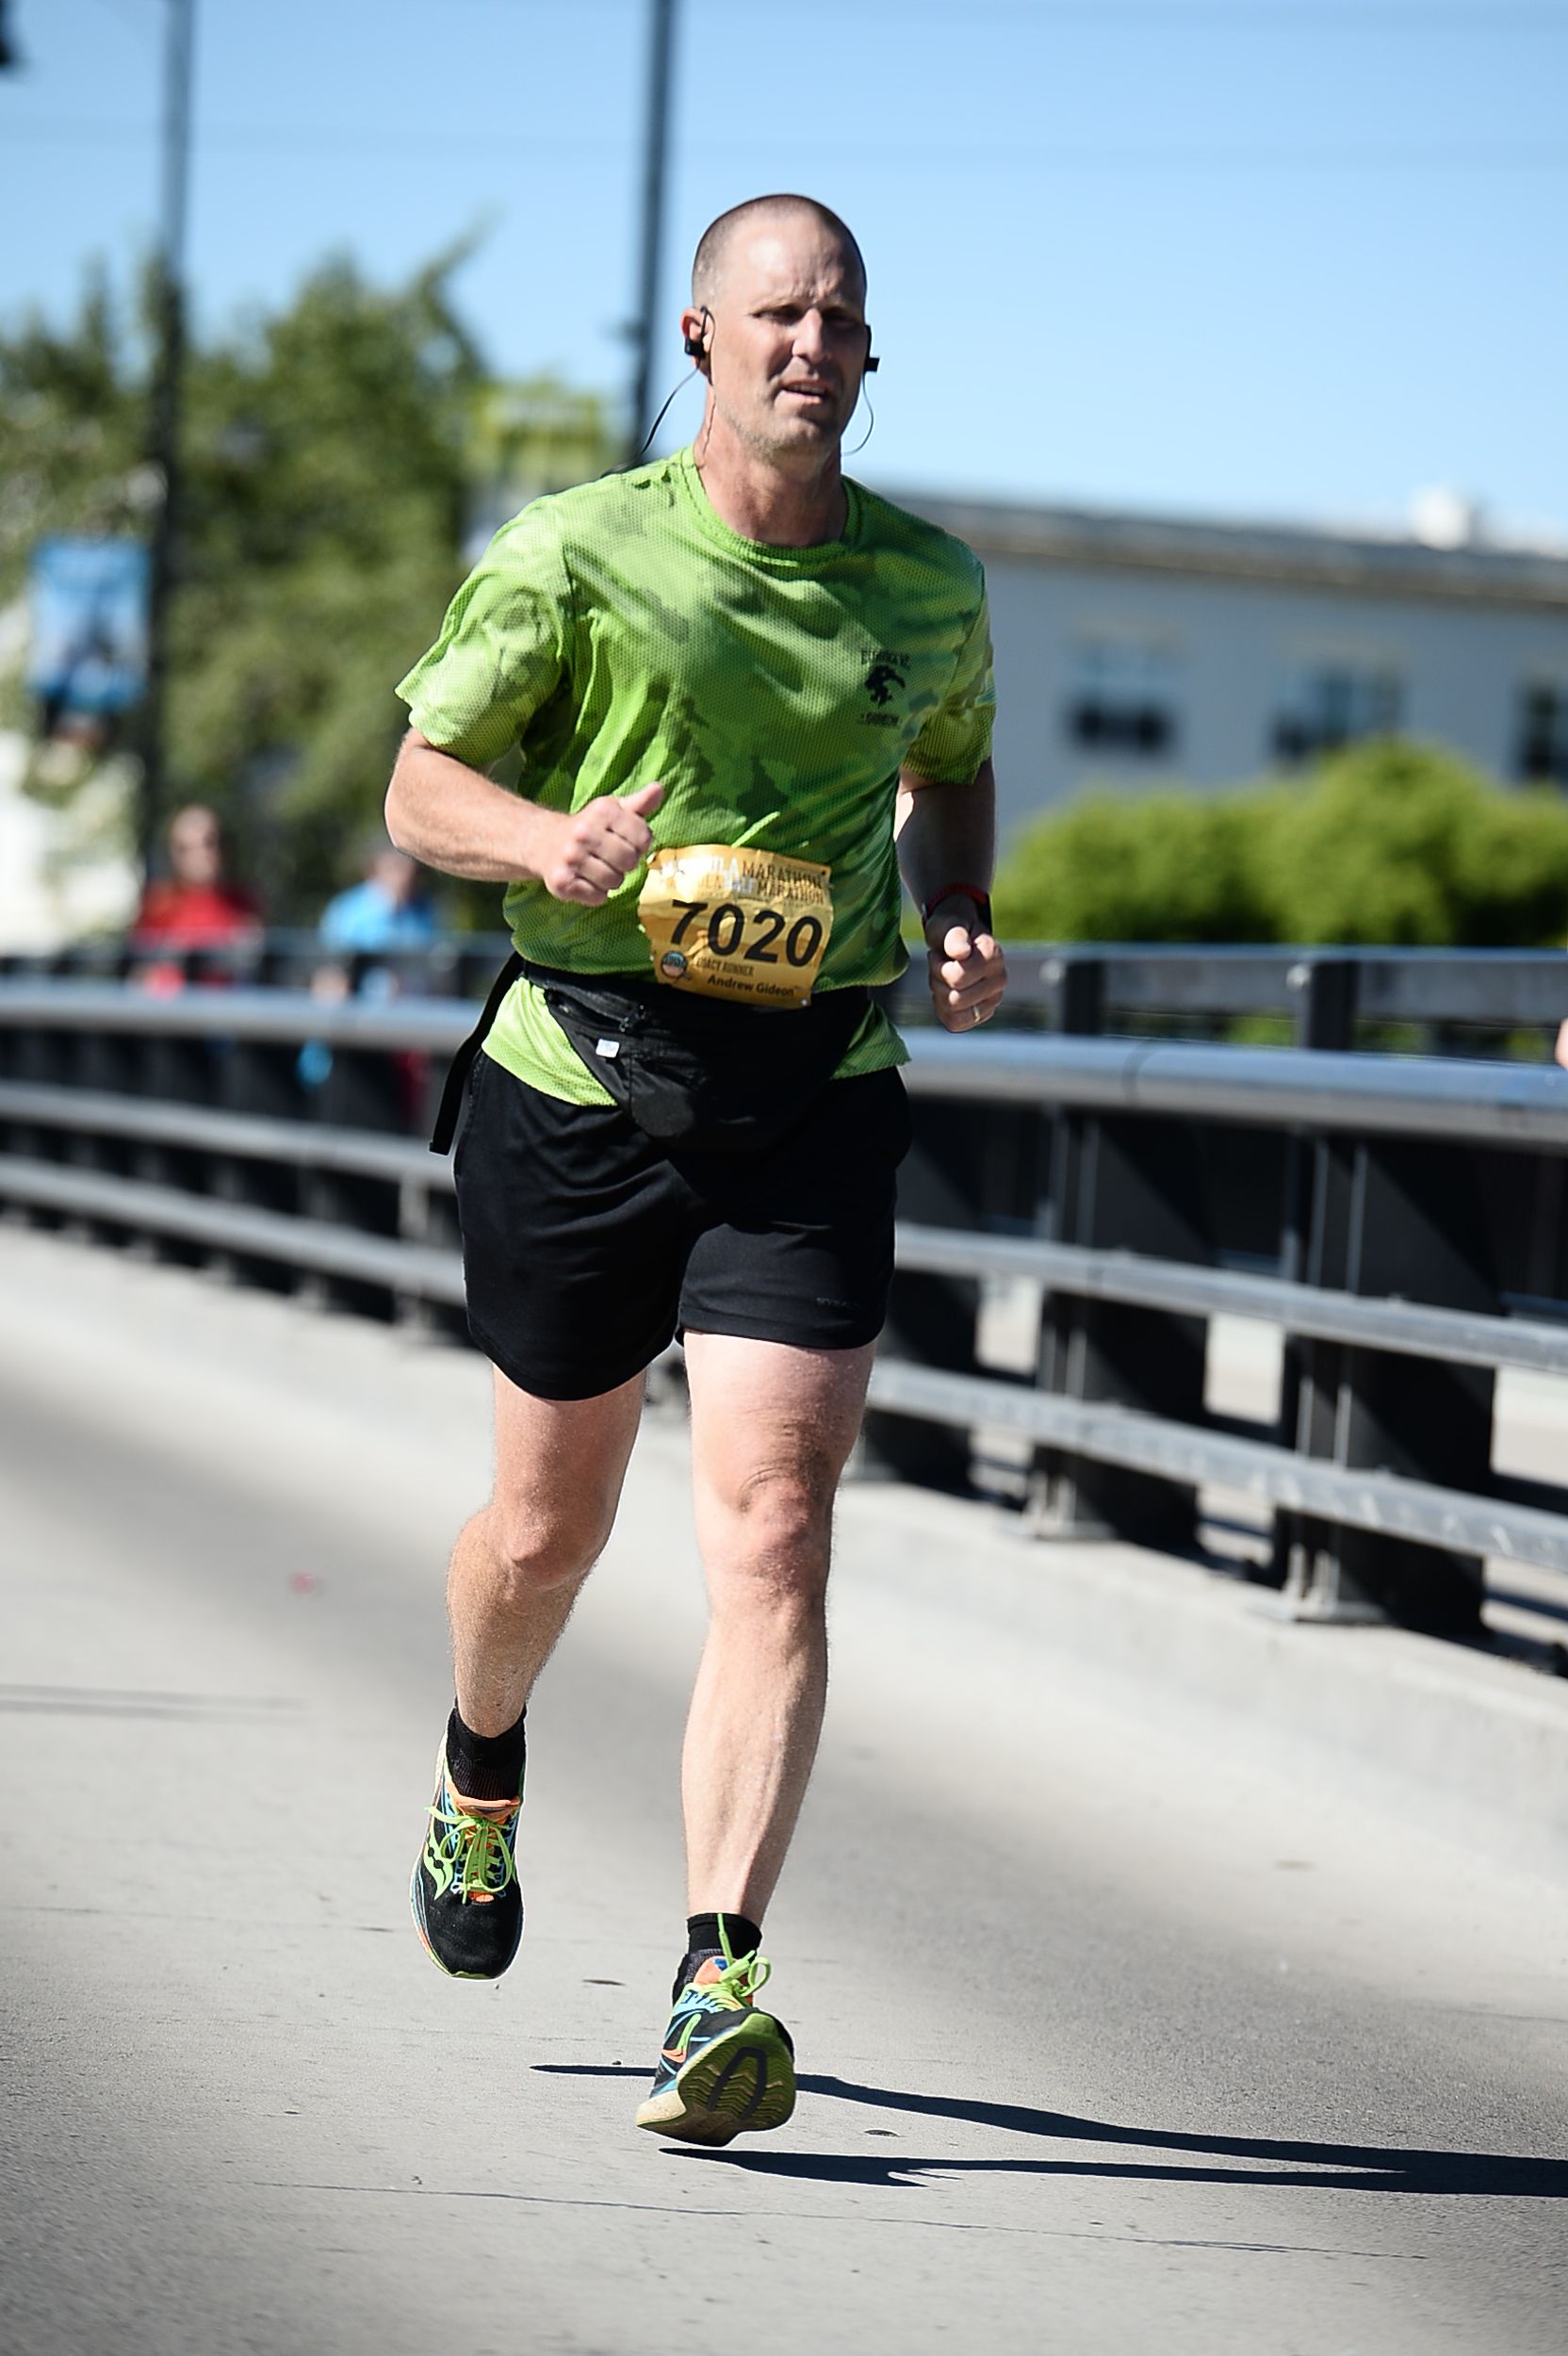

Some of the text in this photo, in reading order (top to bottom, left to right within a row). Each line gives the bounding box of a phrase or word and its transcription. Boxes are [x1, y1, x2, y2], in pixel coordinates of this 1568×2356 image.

[743, 859, 824, 889] MARATHON
[670, 899, 823, 967] 7020
[708, 974, 754, 992] Andrew
